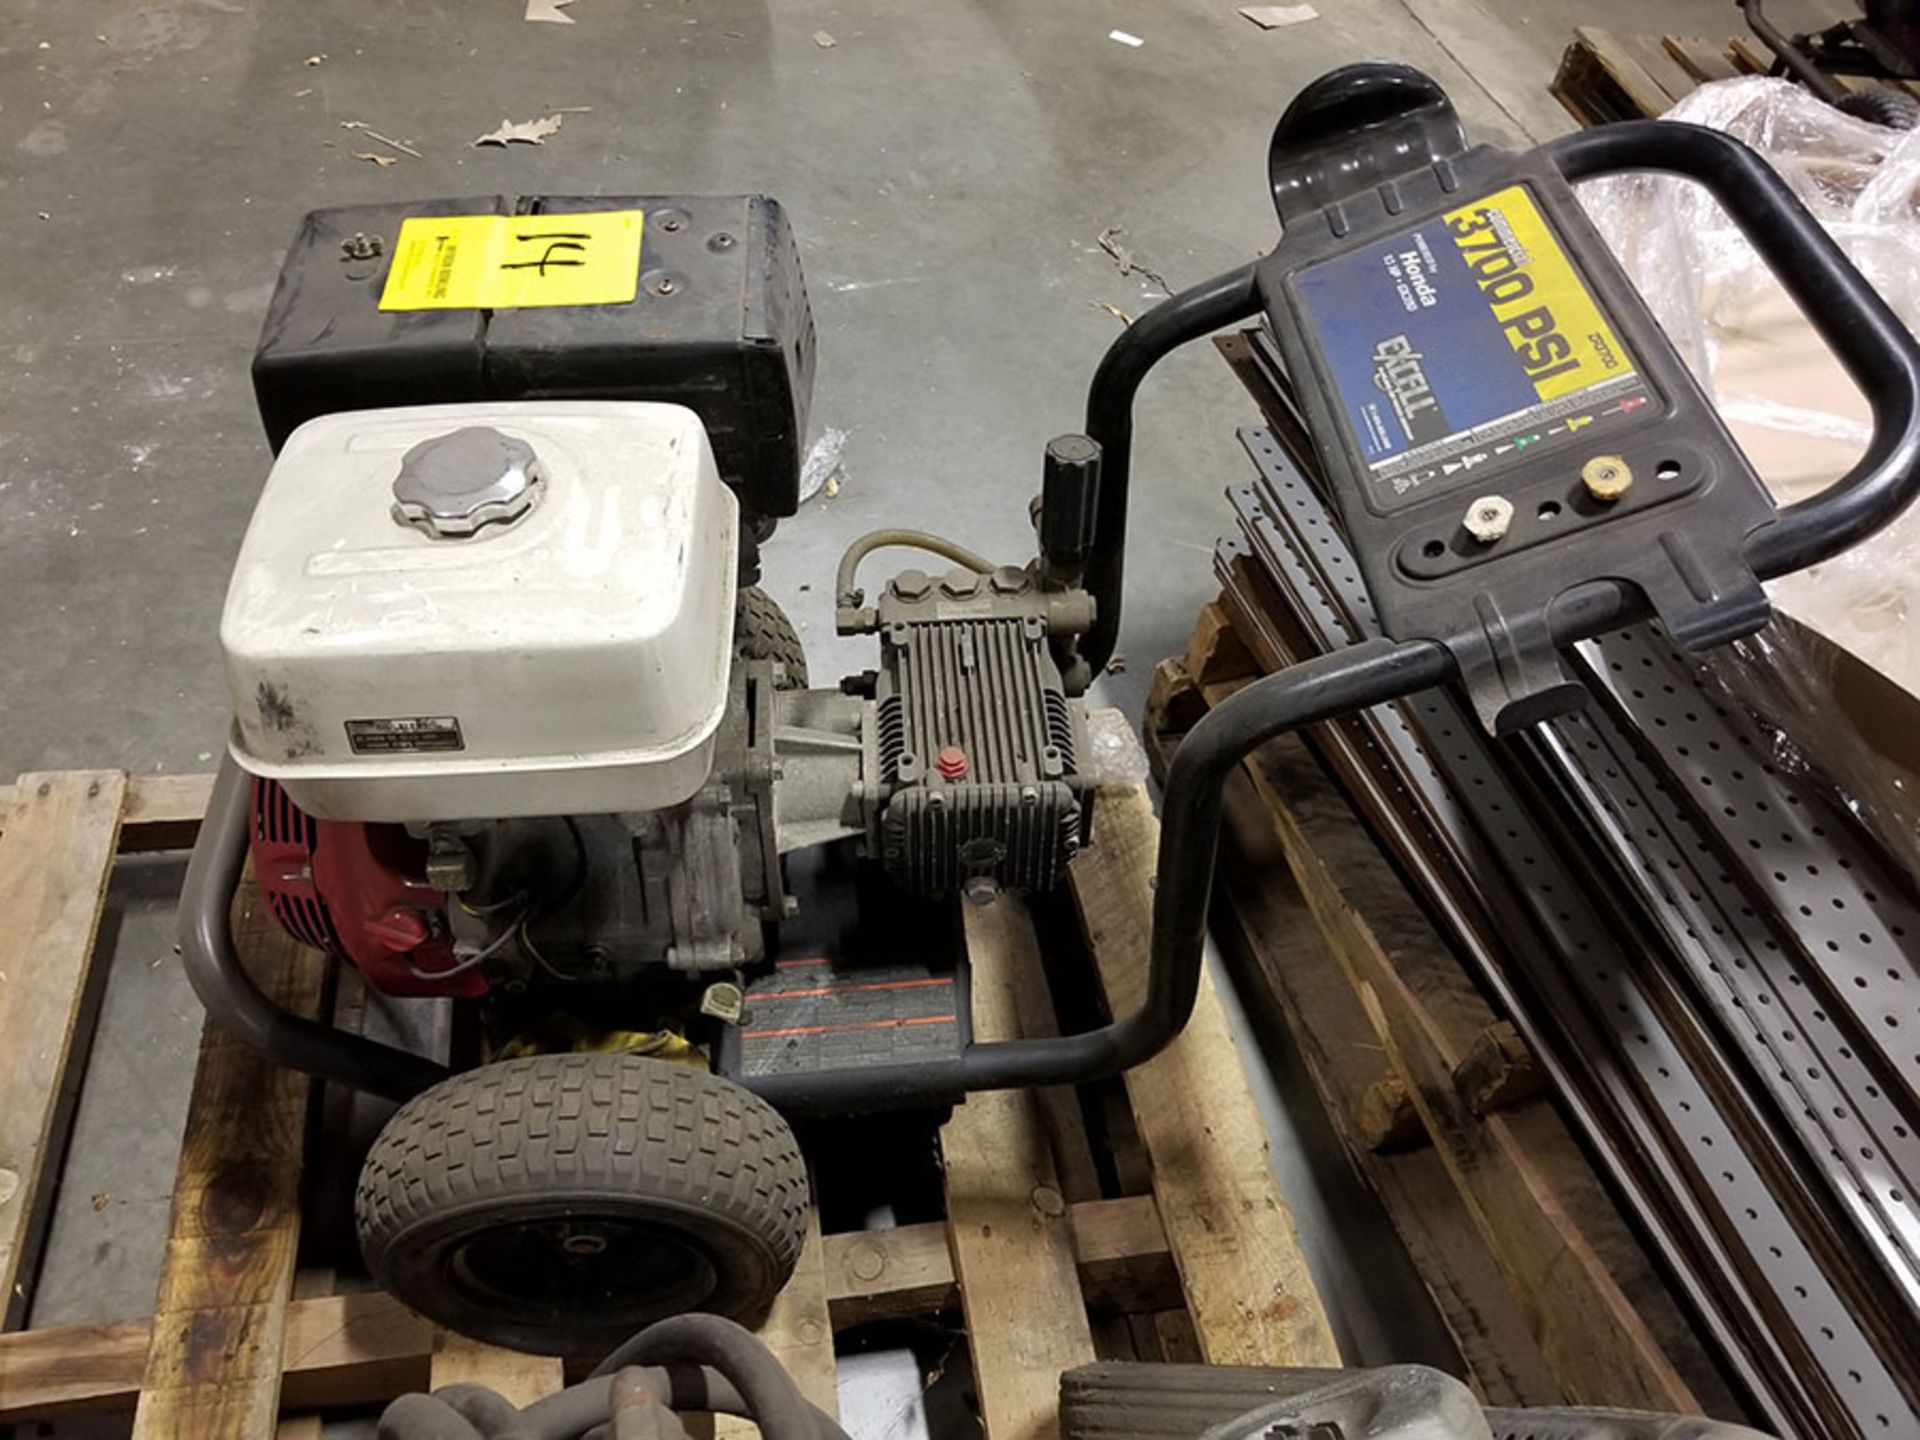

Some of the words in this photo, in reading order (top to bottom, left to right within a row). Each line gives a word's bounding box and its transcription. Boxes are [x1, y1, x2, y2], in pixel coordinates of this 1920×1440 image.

[1399, 250, 1437, 307] Honda
[1448, 208, 1535, 308] 3700
[1503, 306, 1581, 384] PSI
